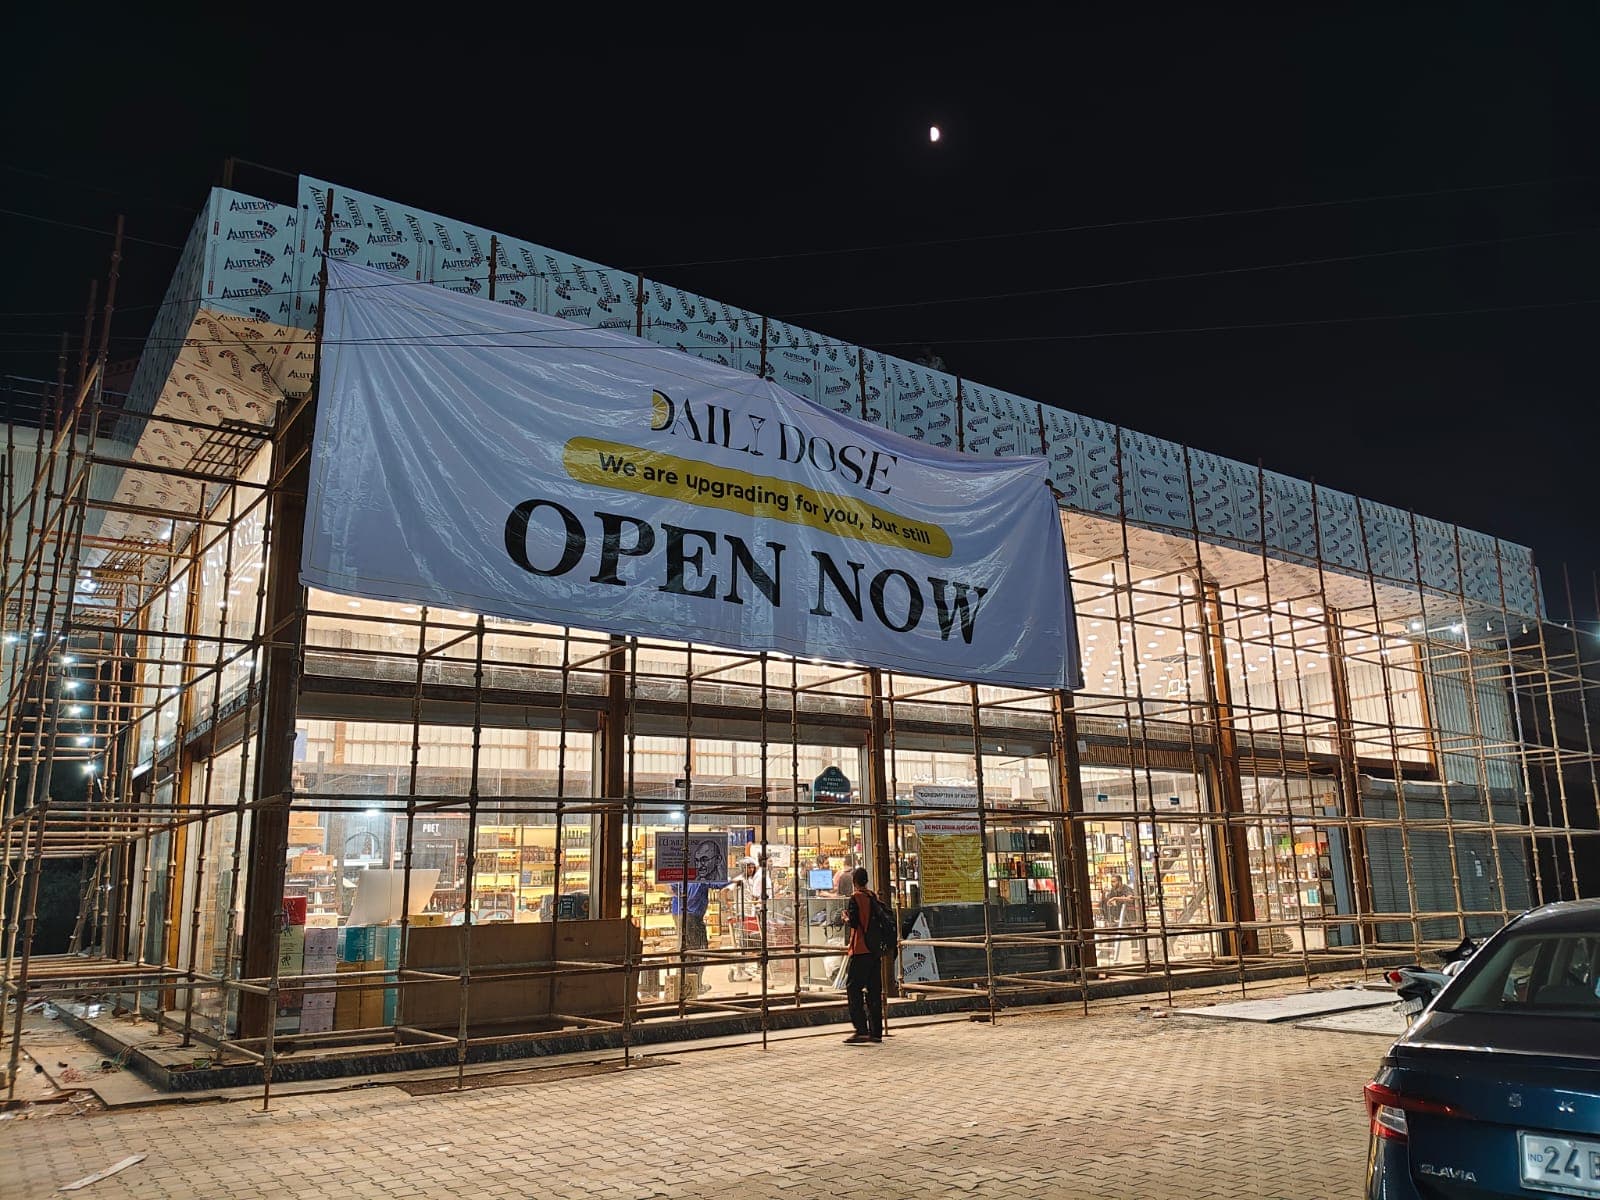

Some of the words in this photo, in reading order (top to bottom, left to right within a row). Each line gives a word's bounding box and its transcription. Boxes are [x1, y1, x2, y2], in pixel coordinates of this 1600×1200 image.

[230, 199, 269, 211] ALUTECH
[226, 228, 266, 240] ALUTECH
[366, 232, 402, 244] ALUTECH
[224, 257, 264, 270] ALUTECH
[442, 258, 474, 269] ALUTECH
[221, 286, 262, 300] ALUTECH
[651, 389, 766, 456] DAILY
[778, 422, 898, 494] DOSE
[599, 452, 637, 477] We
[643, 463, 678, 485] are
[686, 474, 790, 511] upgrading
[794, 494, 819, 516] for
[822, 506, 865, 530] you,
[870, 512, 900, 536] but
[902, 522, 932, 546] still
[504, 499, 786, 608] OPEN
[810, 550, 988, 644] NOW
[1528, 1153, 1544, 1162] IND
[1420, 1163, 1478, 1182] SLAVIA
